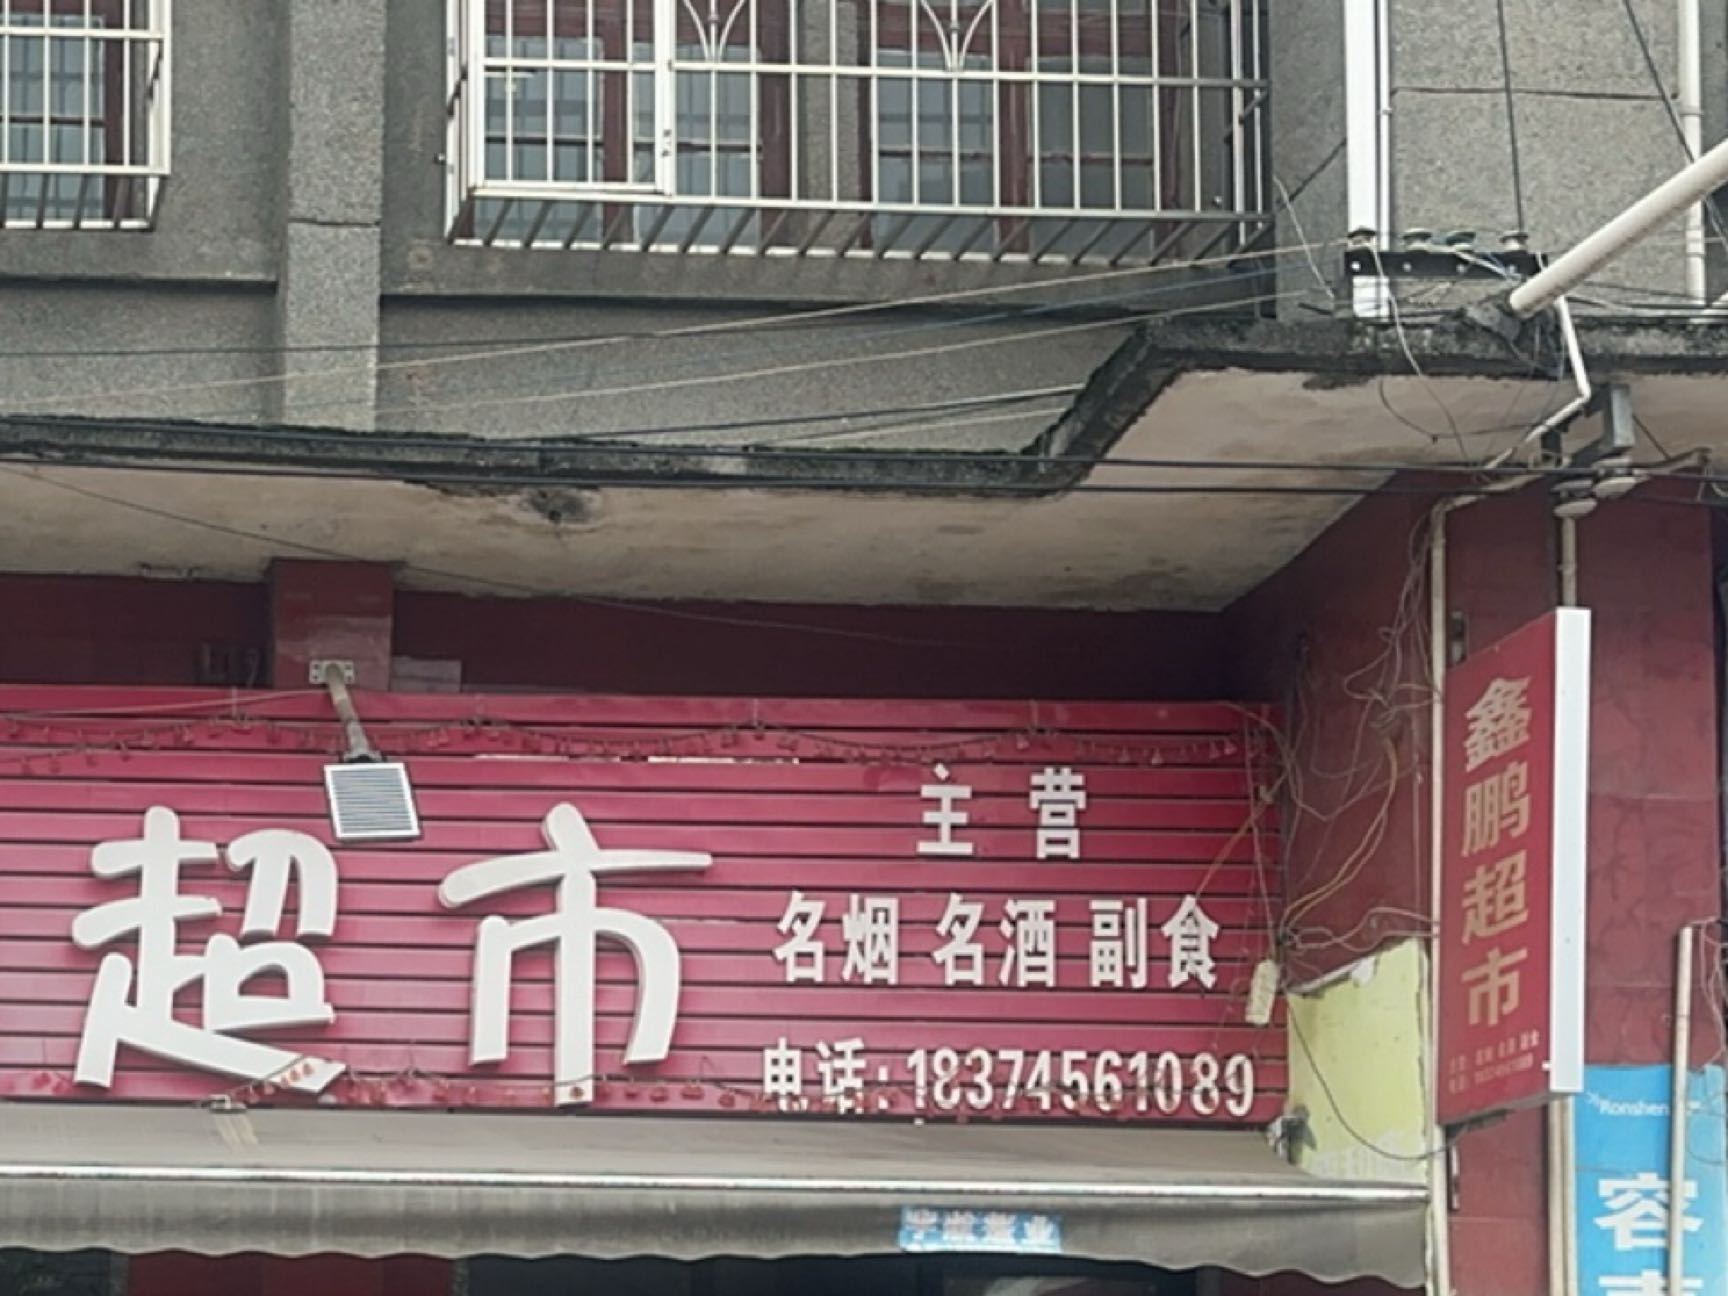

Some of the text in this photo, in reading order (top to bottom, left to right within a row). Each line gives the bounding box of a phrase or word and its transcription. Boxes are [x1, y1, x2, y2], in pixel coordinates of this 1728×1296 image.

[916, 763, 1088, 861] 主营
[1461, 676, 1533, 1028] 鑫鹏超市
[773, 891, 1221, 990] 名烟 名酒 副食
